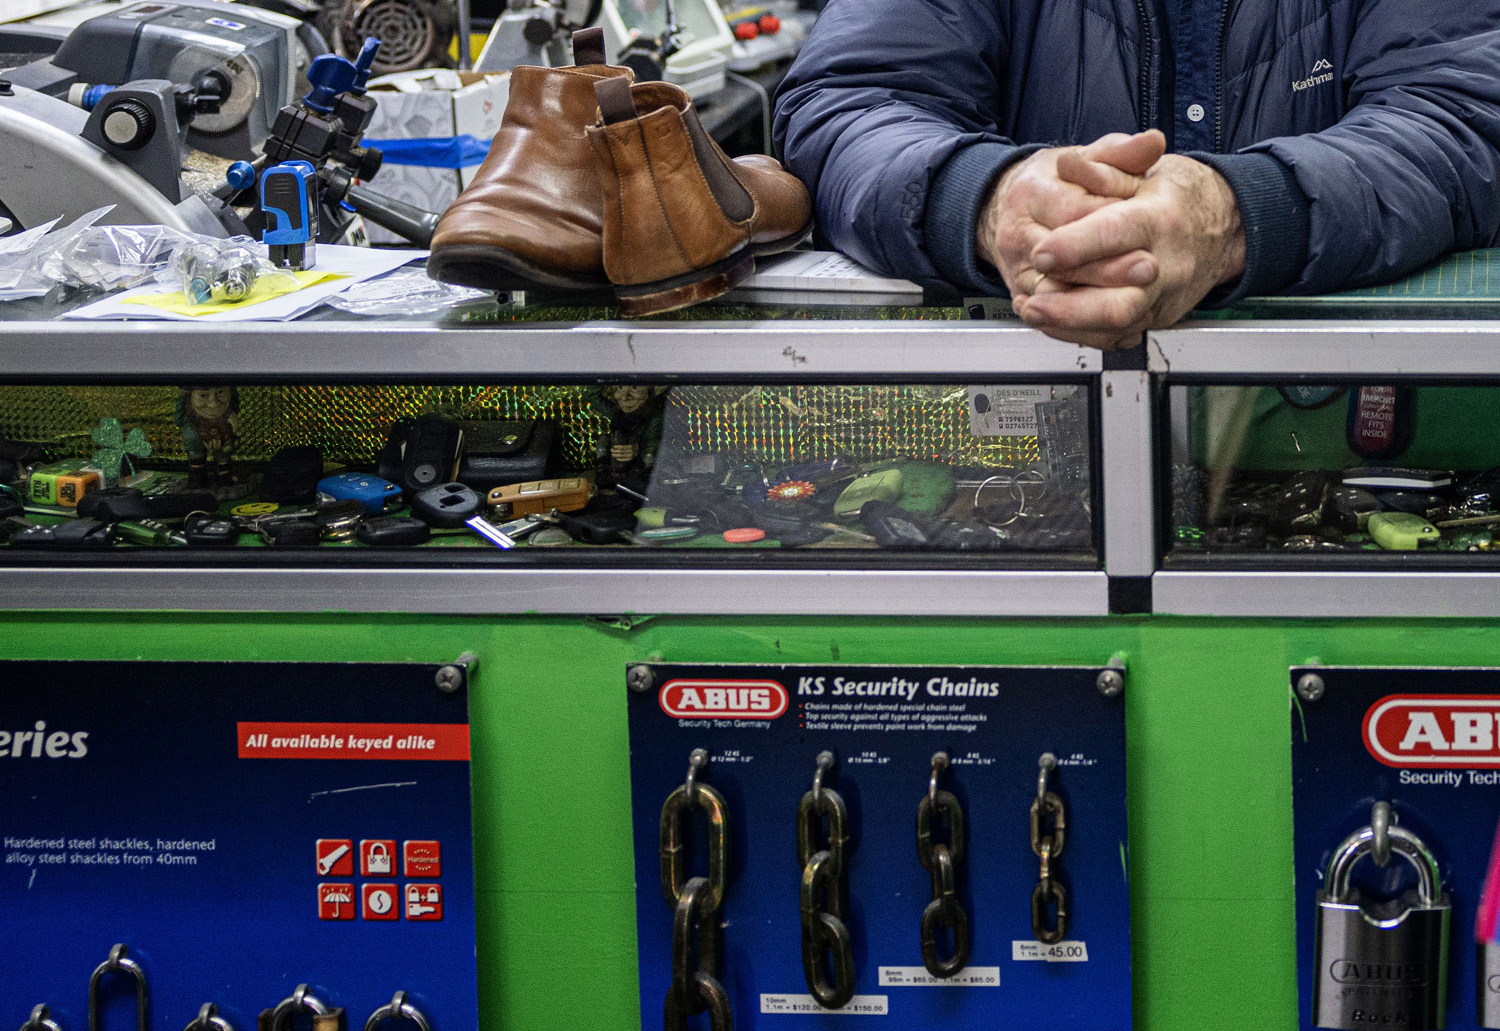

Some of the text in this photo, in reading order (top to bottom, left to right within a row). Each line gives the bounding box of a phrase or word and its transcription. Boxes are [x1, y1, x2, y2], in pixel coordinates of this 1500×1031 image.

[1291, 71, 1334, 92] Kathma
[1361, 394, 1395, 405] IMPORT
[1361, 411, 1394, 421] REMOTE
[1368, 421, 1385, 429] FITS
[1361, 429, 1388, 438] INSIDE
[797, 677, 999, 701] KS Security Chains
[677, 688, 770, 710] ABUS
[805, 702, 830, 710] Chains
[831, 702, 852, 710] made
[853, 702, 863, 710] of
[863, 702, 899, 711] hardened
[900, 703, 925, 713] special
[949, 703, 966, 711] steel
[805, 712, 819, 721] Top
[820, 713, 848, 721] security
[849, 713, 878, 722] against
[890, 713, 909, 722] types
[920, 713, 958, 722] aggressive
[960, 713, 987, 721] attacks
[678, 719, 771, 729] Security Tech Germany
[806, 722, 829, 730] Textile
[853, 723, 884, 731] prevents
[885, 723, 905, 731] paint
[945, 723, 977, 733] damage
[246, 734, 436, 752] All available keyed alike
[1400, 770, 1462, 787] Security
[4, 837, 216, 851] Hardened steel shackles, hardened
[6, 853, 197, 866] alloy steel shackles from 40mm
[1048, 946, 1082, 957] 45.00
